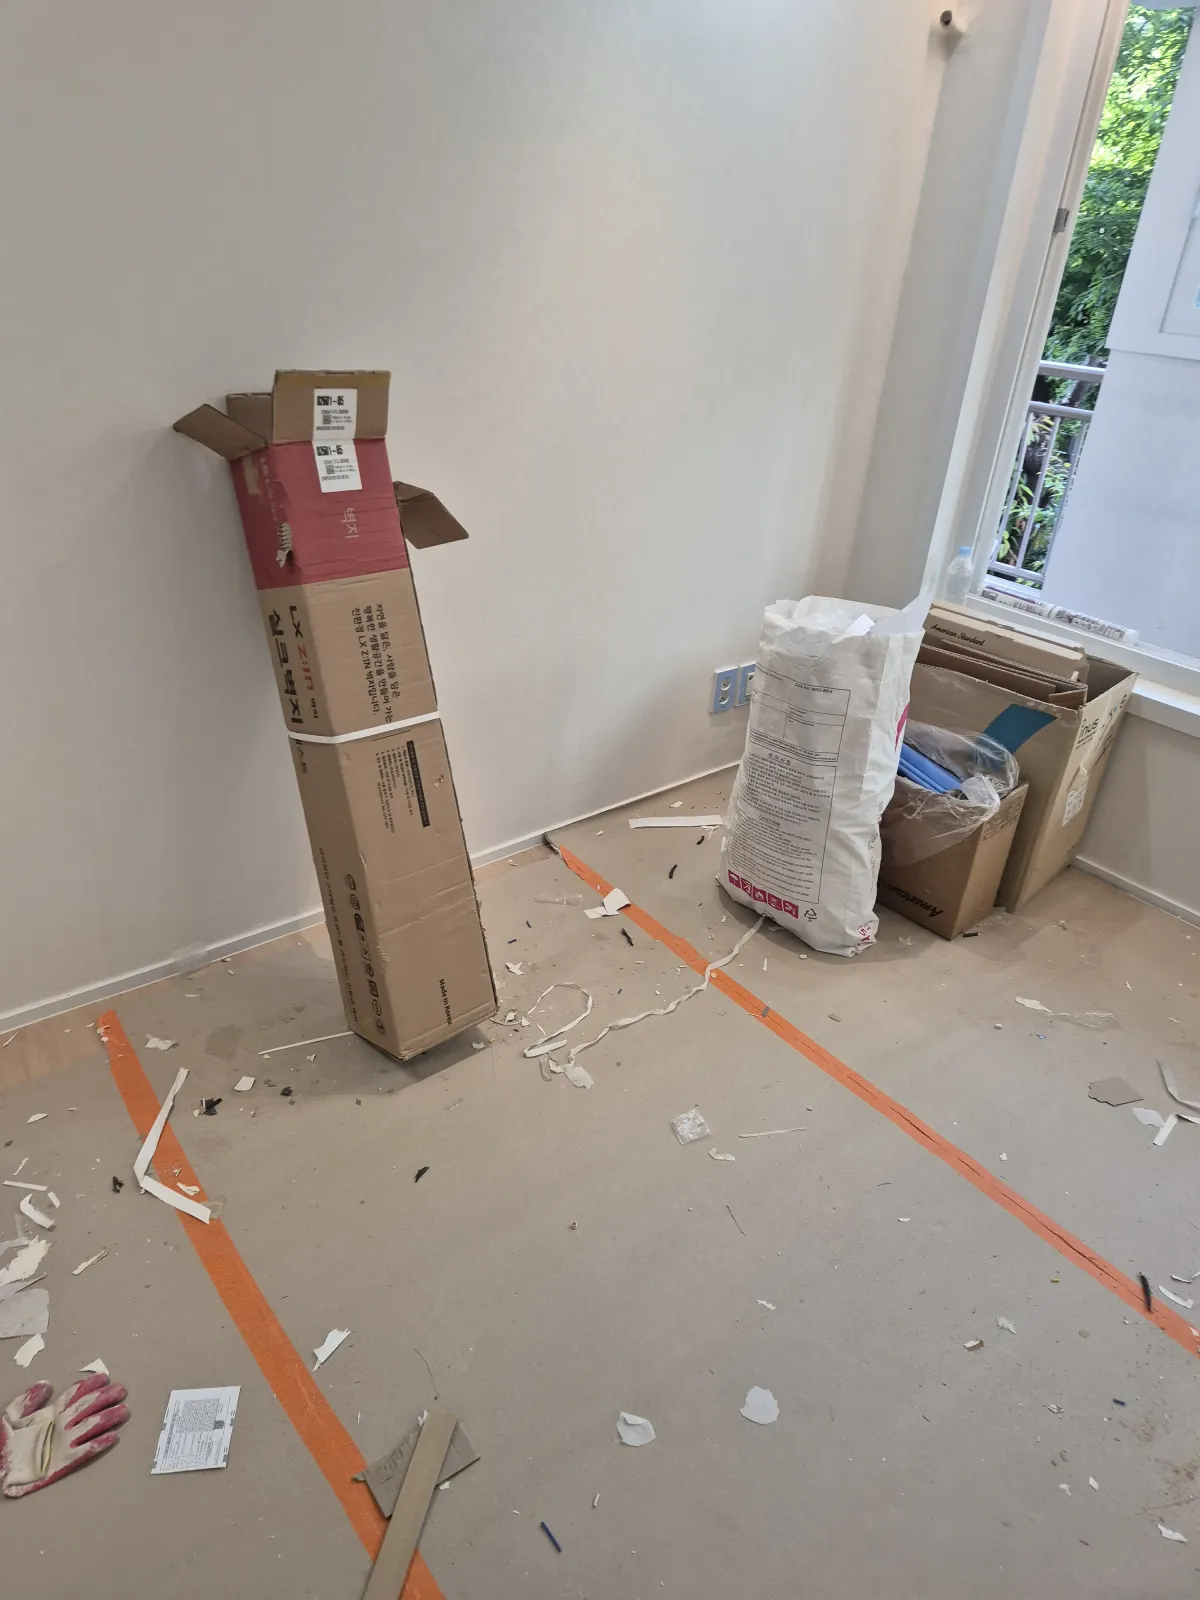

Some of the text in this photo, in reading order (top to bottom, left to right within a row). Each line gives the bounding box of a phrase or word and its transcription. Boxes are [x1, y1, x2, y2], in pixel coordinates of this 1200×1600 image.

[341, 508, 360, 538] 벽지
[352, 608, 364, 633] 친환경
[358, 635, 367, 648] LX
[376, 604, 387, 629] 자연을
[386, 654, 397, 679] 사람을
[930, 624, 986, 646] American Standard
[268, 610, 303, 724] 실크벽지
[289, 605, 303, 638] LX
[311, 698, 319, 718] 벽지
[363, 605, 394, 723] 행복한 생활공간을 만들어 가는
[439, 978, 447, 997] Made
[444, 1005, 452, 1025] Korea
